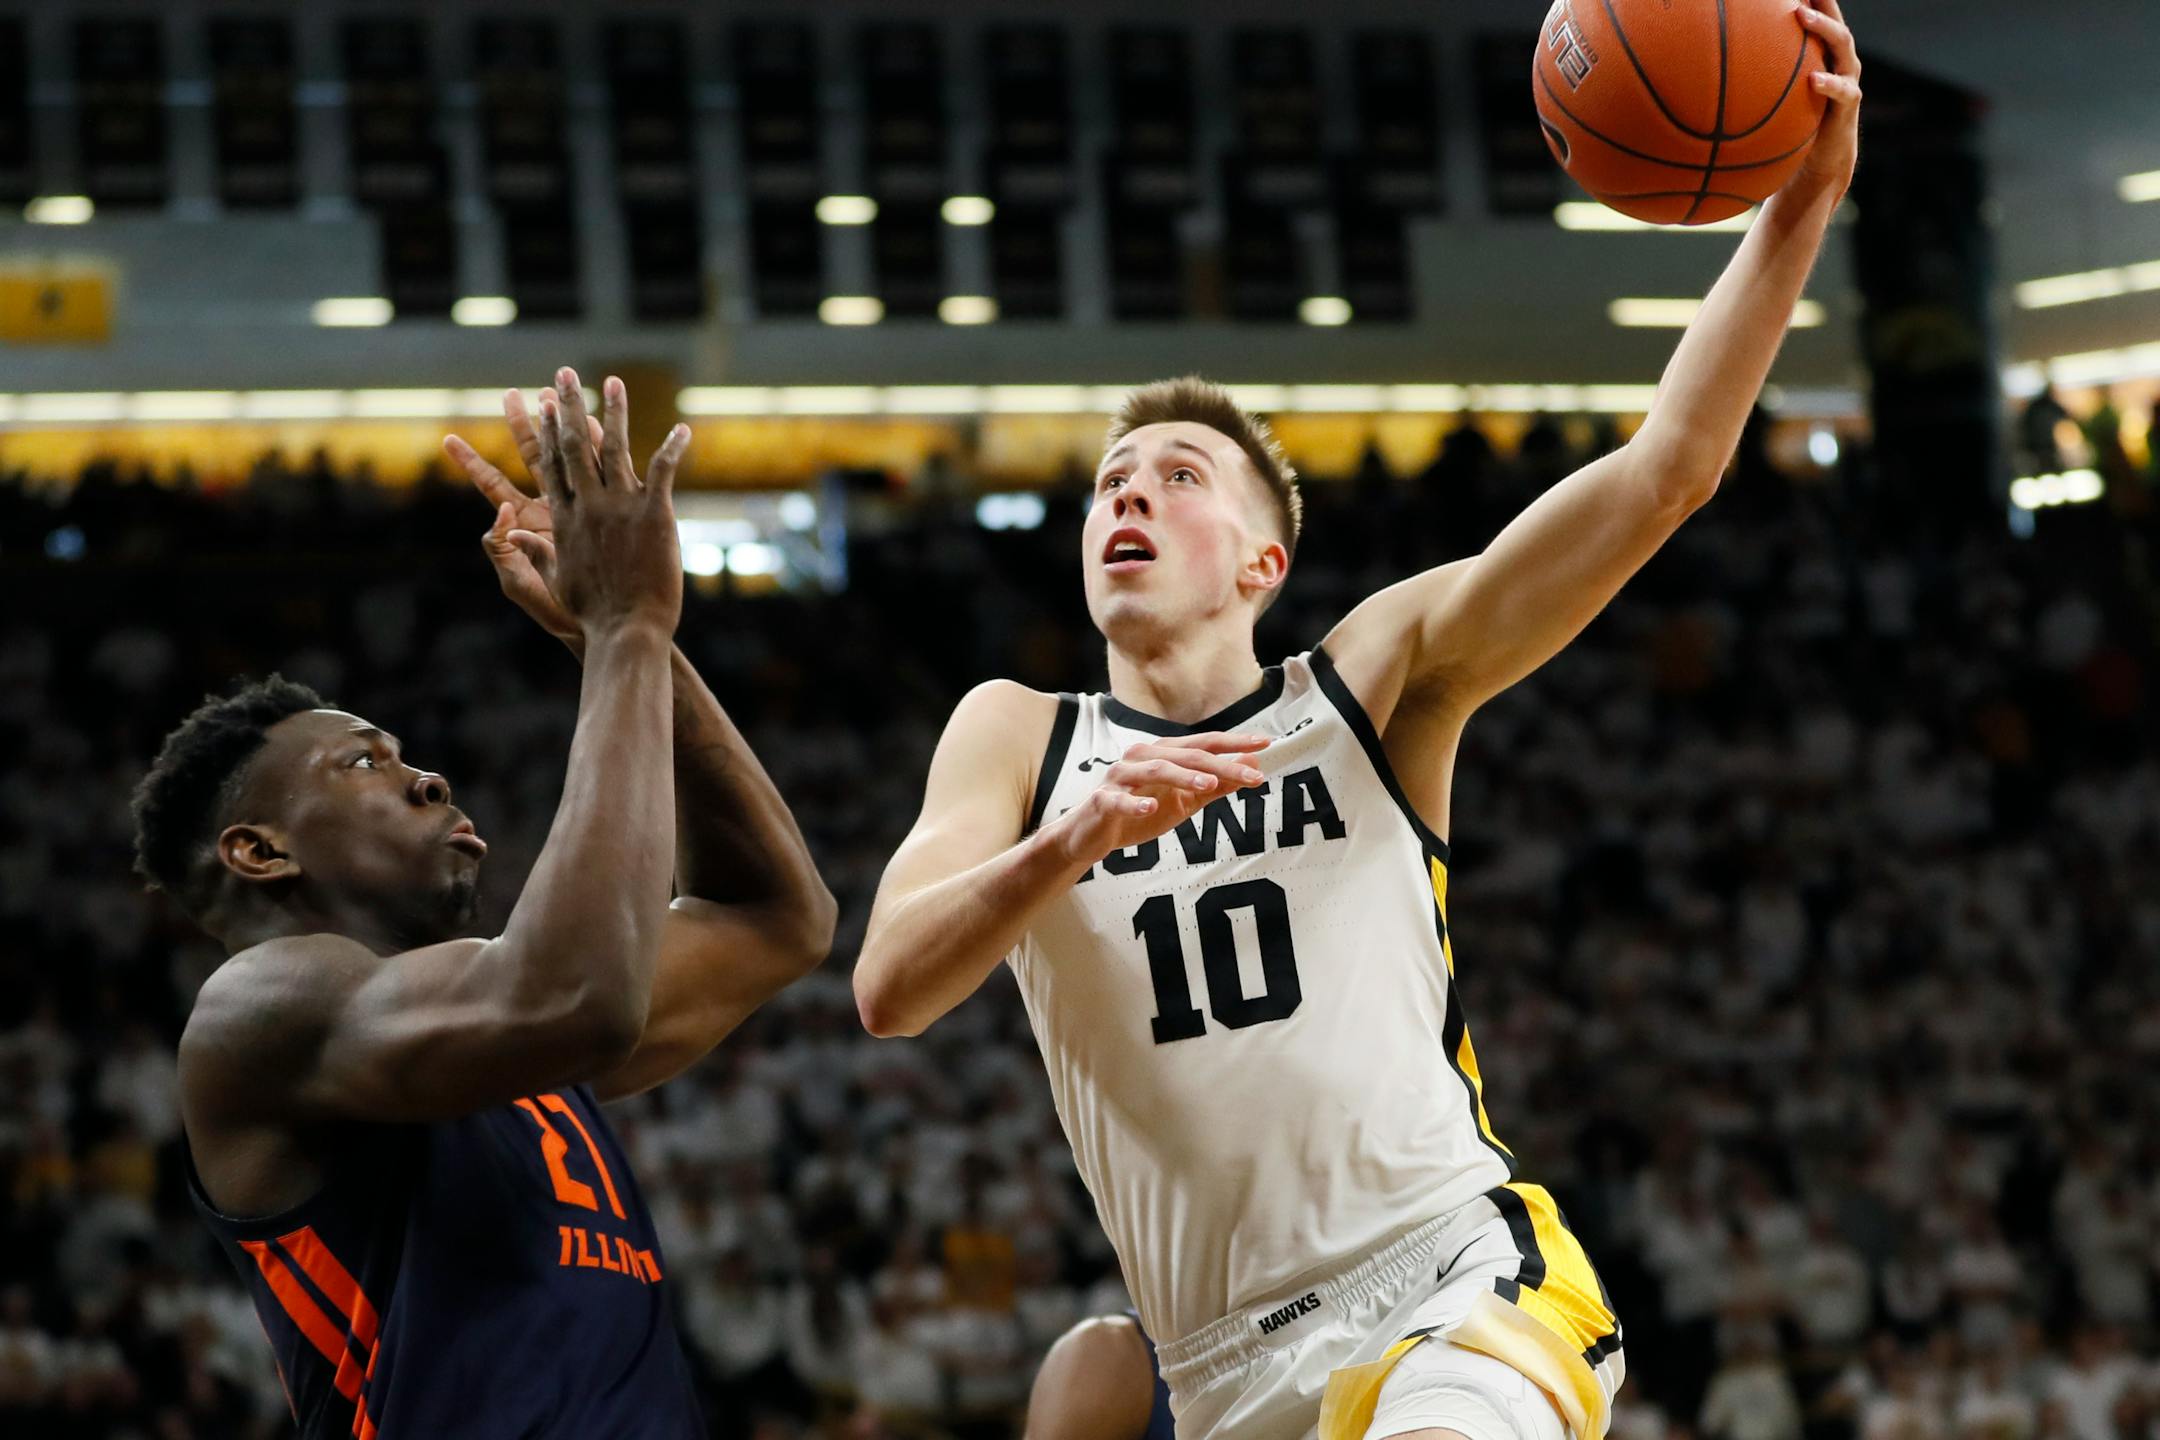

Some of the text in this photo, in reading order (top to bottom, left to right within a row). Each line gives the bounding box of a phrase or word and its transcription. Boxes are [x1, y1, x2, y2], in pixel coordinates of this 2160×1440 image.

[1061, 766, 1346, 884] WA
[1133, 878, 1302, 1044] 10
[1258, 1292, 1321, 1335] HAWKS
